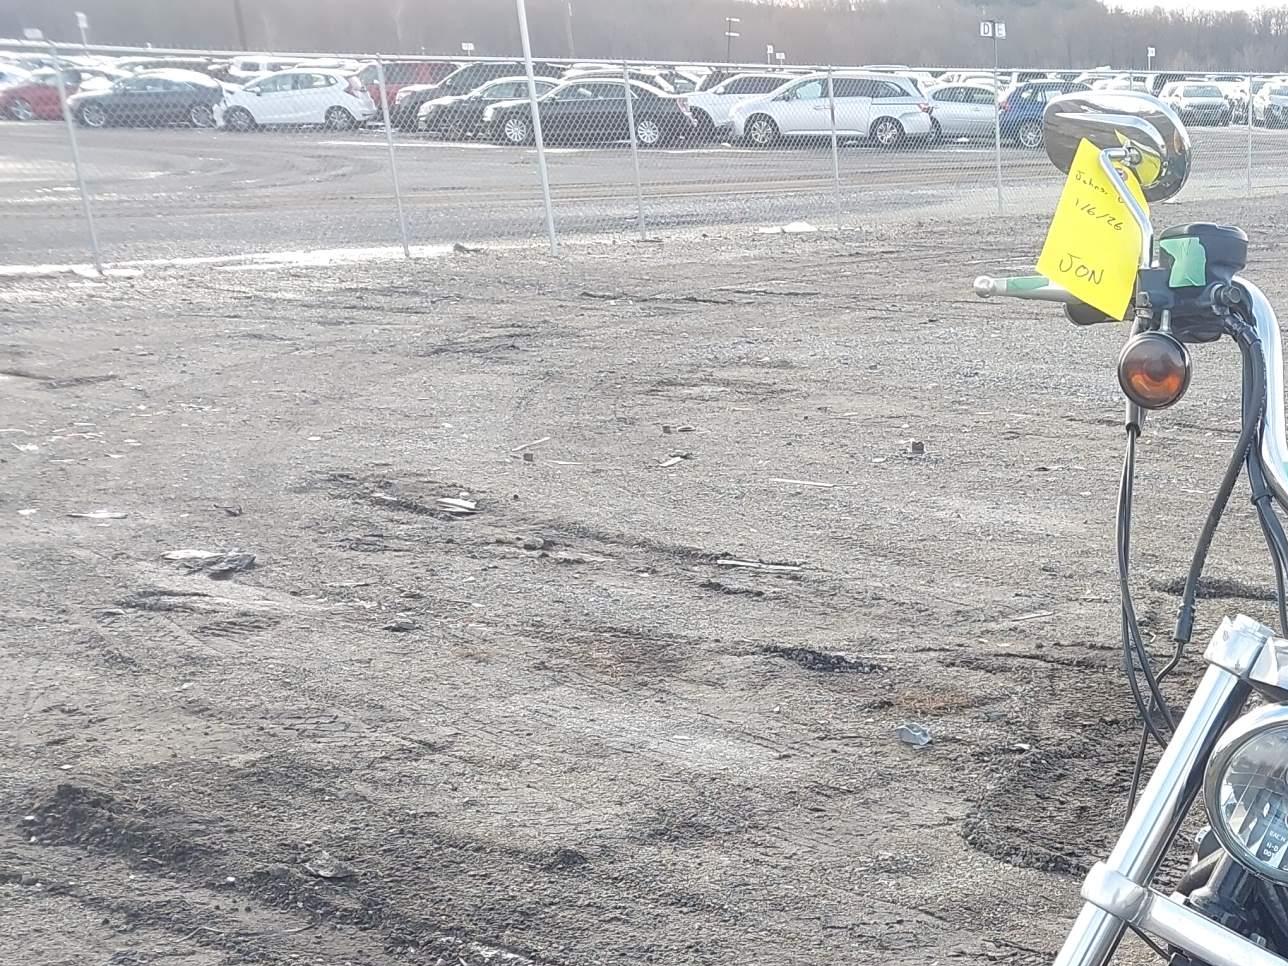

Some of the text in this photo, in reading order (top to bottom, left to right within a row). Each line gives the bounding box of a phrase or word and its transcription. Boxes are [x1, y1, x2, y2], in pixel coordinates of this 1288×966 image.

[983, 22, 990, 35] D
[1075, 198, 1123, 231] 1/6/26
[1058, 252, 1105, 285] JON
